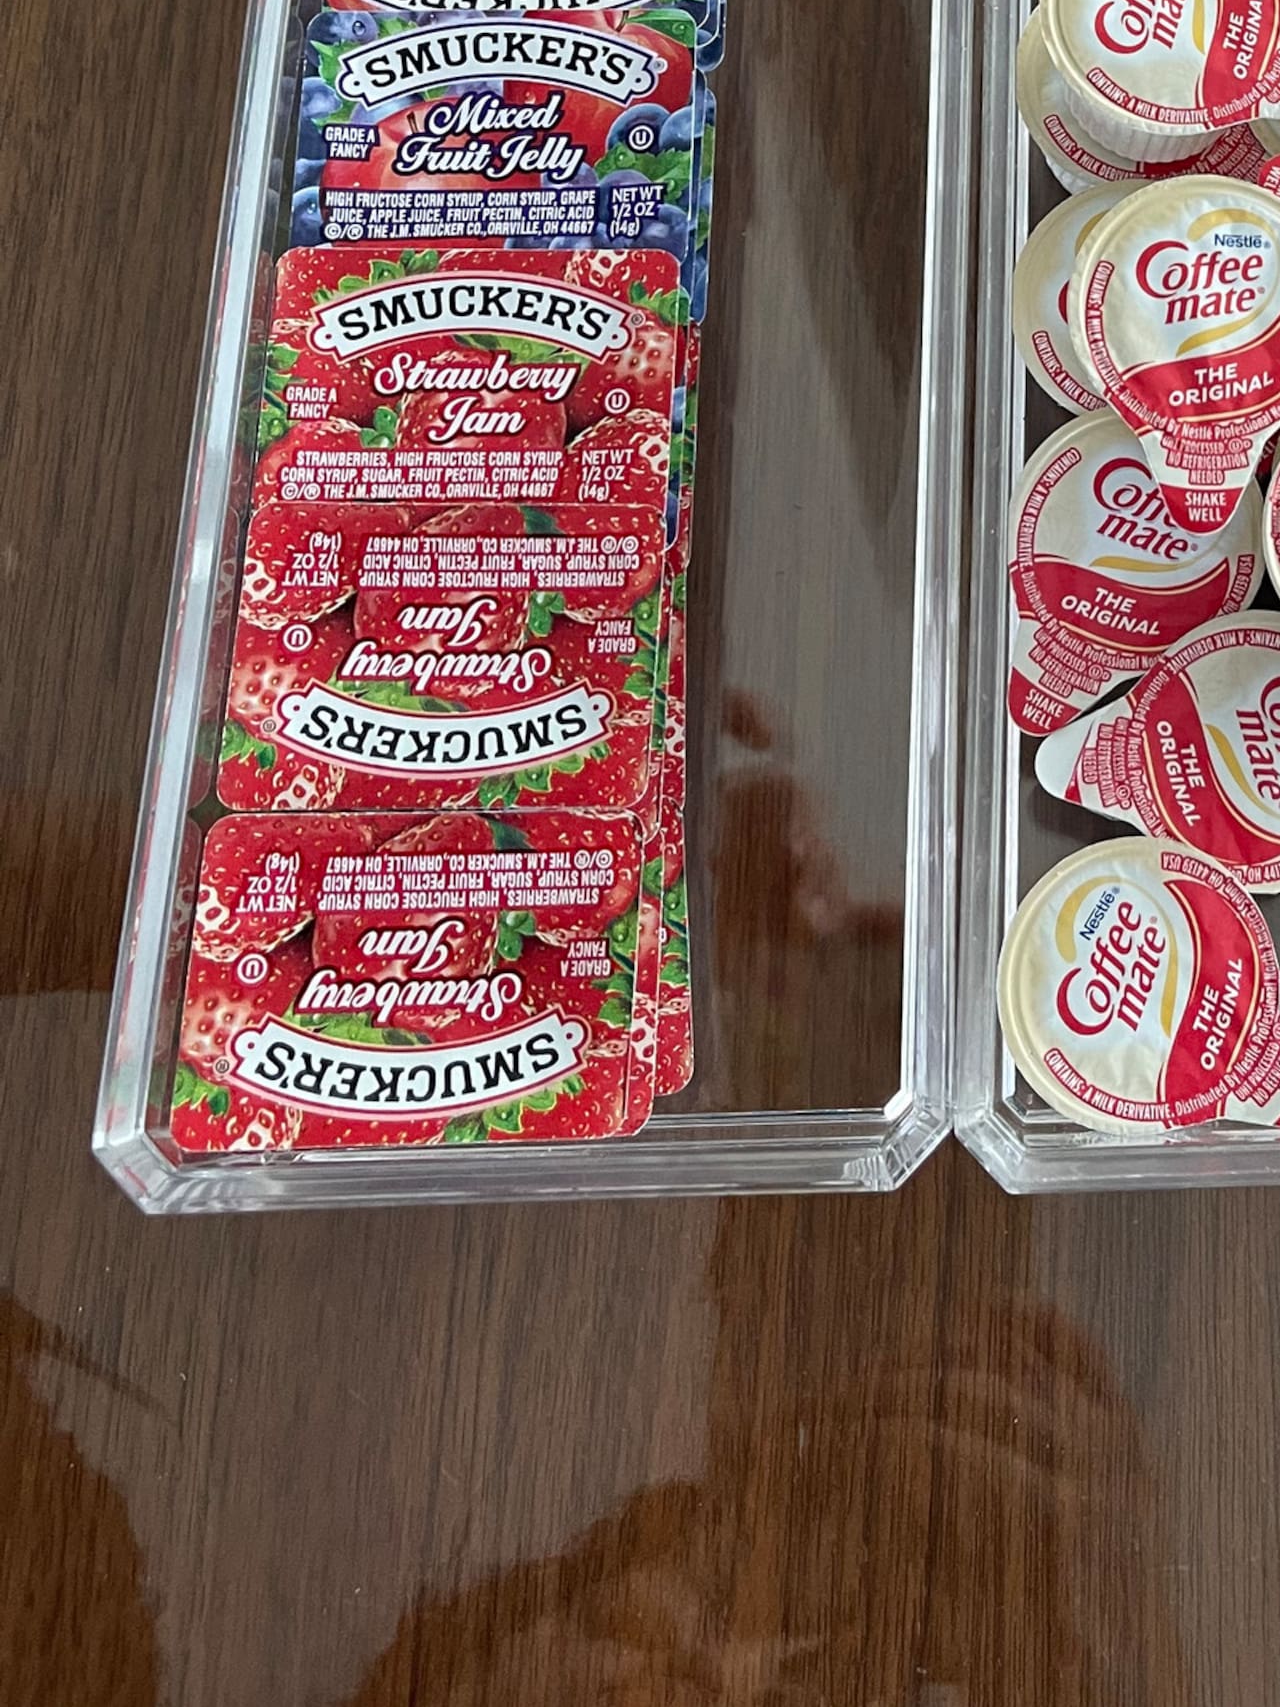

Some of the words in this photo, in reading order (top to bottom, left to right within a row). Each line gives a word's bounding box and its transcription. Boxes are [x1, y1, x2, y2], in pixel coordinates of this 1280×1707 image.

[1223, 12, 1244, 50] THE
[364, 31, 634, 88] SMUCKER'S
[429, 94, 562, 134] Mixed
[325, 128, 364, 143] GRADE
[366, 129, 376, 143] A
[330, 143, 369, 159] FANCY
[396, 138, 493, 174] Fruit
[491, 133, 584, 180] Jelly
[325, 191, 356, 207] HIGH
[356, 193, 414, 207] FRUCTOSE
[414, 193, 446, 207] CORN
[488, 192, 518, 207] CORN
[561, 190, 596, 205] GRAPE
[369, 209, 406, 223] APPLE
[447, 208, 482, 221] FRUIT
[528, 206, 567, 220] CITRIC
[568, 205, 594, 219] ACID
[612, 189, 637, 202] NET
[640, 186, 663, 200] WT
[612, 204, 631, 218] 1/2
[634, 202, 654, 216] OZ
[367, 225, 388, 238] THE
[413, 223, 463, 237] SMUCKER
[610, 218, 640, 237] (14g)
[1214, 233, 1262, 248] Nestlé
[1135, 240, 1263, 298] Coffee
[338, 285, 612, 341] SMUCKER'S
[1165, 288, 1256, 324] mate
[373, 353, 578, 402] Strawberry
[1169, 372, 1274, 406] ORIGINAL
[1194, 364, 1237, 384] THE
[286, 387, 326, 402] GRADE
[327, 388, 338, 402] A
[290, 403, 330, 418] FANCY
[428, 397, 525, 442] Jam
[1185, 491, 1226, 505] SHAKE
[1189, 507, 1222, 521] WELL
[1096, 514, 1189, 560] mate
[1061, 596, 1161, 636] ORIGINAL
[1096, 588, 1137, 614] THE
[398, 598, 497, 647] Jam
[342, 641, 552, 692] Strawberry
[1021, 704, 1052, 729] WELL
[1025, 690, 1065, 718] SHAKE
[300, 704, 587, 762] SMUCKER'S
[1157, 721, 1201, 826] ORIGINAL
[1181, 744, 1205, 789] THE
[358, 920, 465, 974] Jam
[1056, 902, 1141, 1036] Coffee
[1118, 924, 1166, 1031] mate
[300, 971, 523, 1024] Strawberry
[1192, 985, 1219, 1033] THE
[1201, 958, 1242, 1070] ORIGINAL
[254, 1032, 560, 1103] SMUCKER'S
